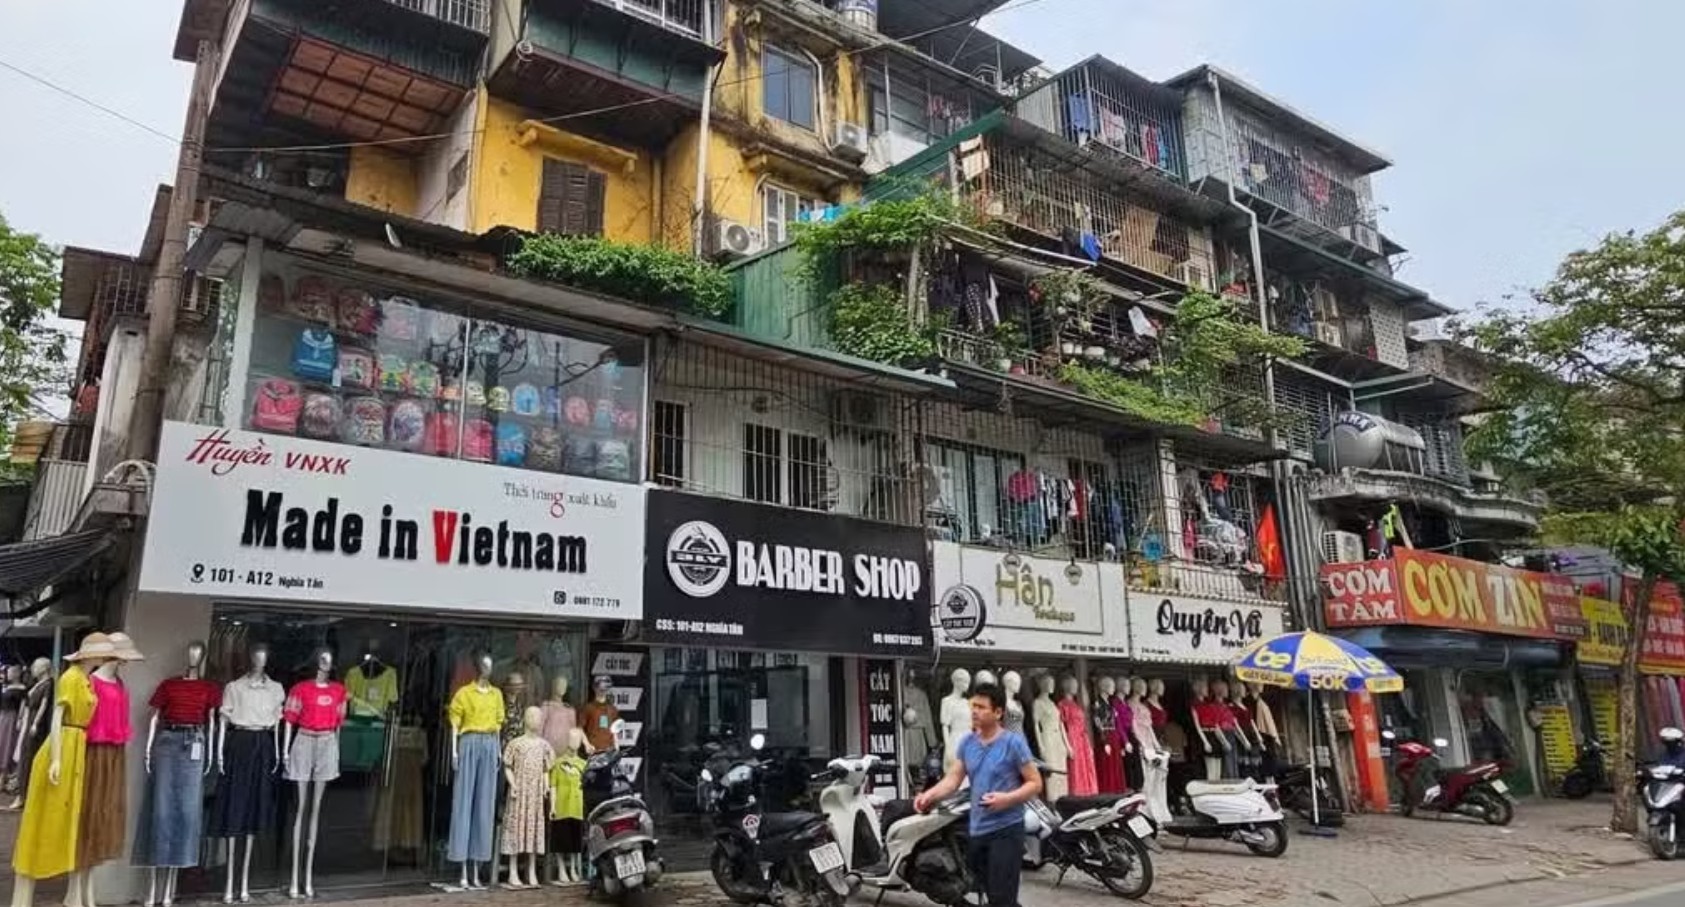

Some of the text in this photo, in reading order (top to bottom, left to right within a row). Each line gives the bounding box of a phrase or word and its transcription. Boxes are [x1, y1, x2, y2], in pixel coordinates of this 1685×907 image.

[186, 429, 351, 476] Huyền VNXK
[532, 487, 565, 518] trang
[240, 489, 586, 573] Made in Vietnam
[210, 568, 235, 583] 101
[246, 571, 274, 585] A12
[737, 540, 920, 600] BARBER SHOP
[1328, 564, 1392, 597] CƠM
[1404, 558, 1548, 629] CƠM ZIN
[1156, 599, 1230, 649] Quyên
[1254, 645, 1292, 669] be
[870, 699, 892, 721] TÓC
[870, 734, 894, 753] NAM
